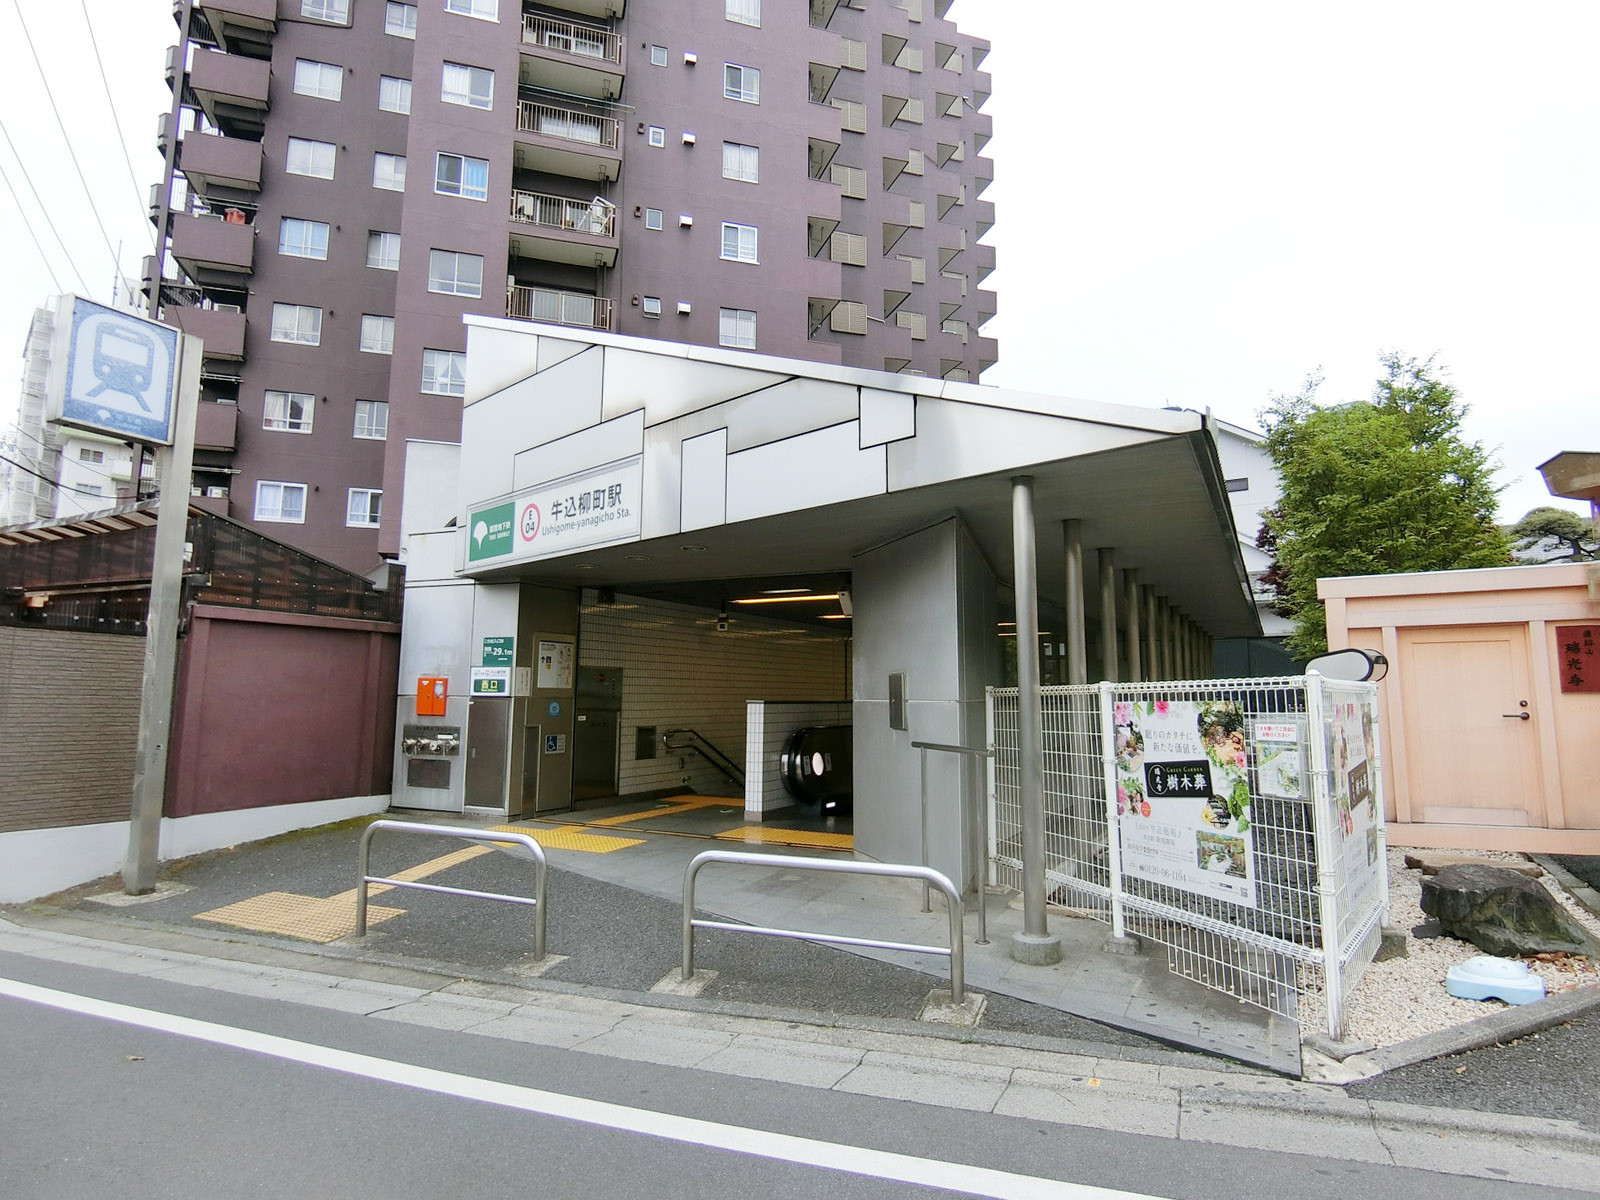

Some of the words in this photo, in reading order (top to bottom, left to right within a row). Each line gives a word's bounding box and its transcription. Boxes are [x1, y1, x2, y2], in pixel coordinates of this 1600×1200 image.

[551, 483, 622, 521] 牛込柳町駅
[528, 510, 533, 520] E
[542, 512, 615, 537] Ushigome-yanagicho
[616, 507, 632, 519] Sta.
[525, 522, 535, 534] 04
[493, 647, 512, 656] 29.1m
[1145, 729, 1193, 741] 眠りのカタチに
[1167, 773, 1208, 791] 樹木葬
[1145, 864, 1187, 882] 0120-06-1194
